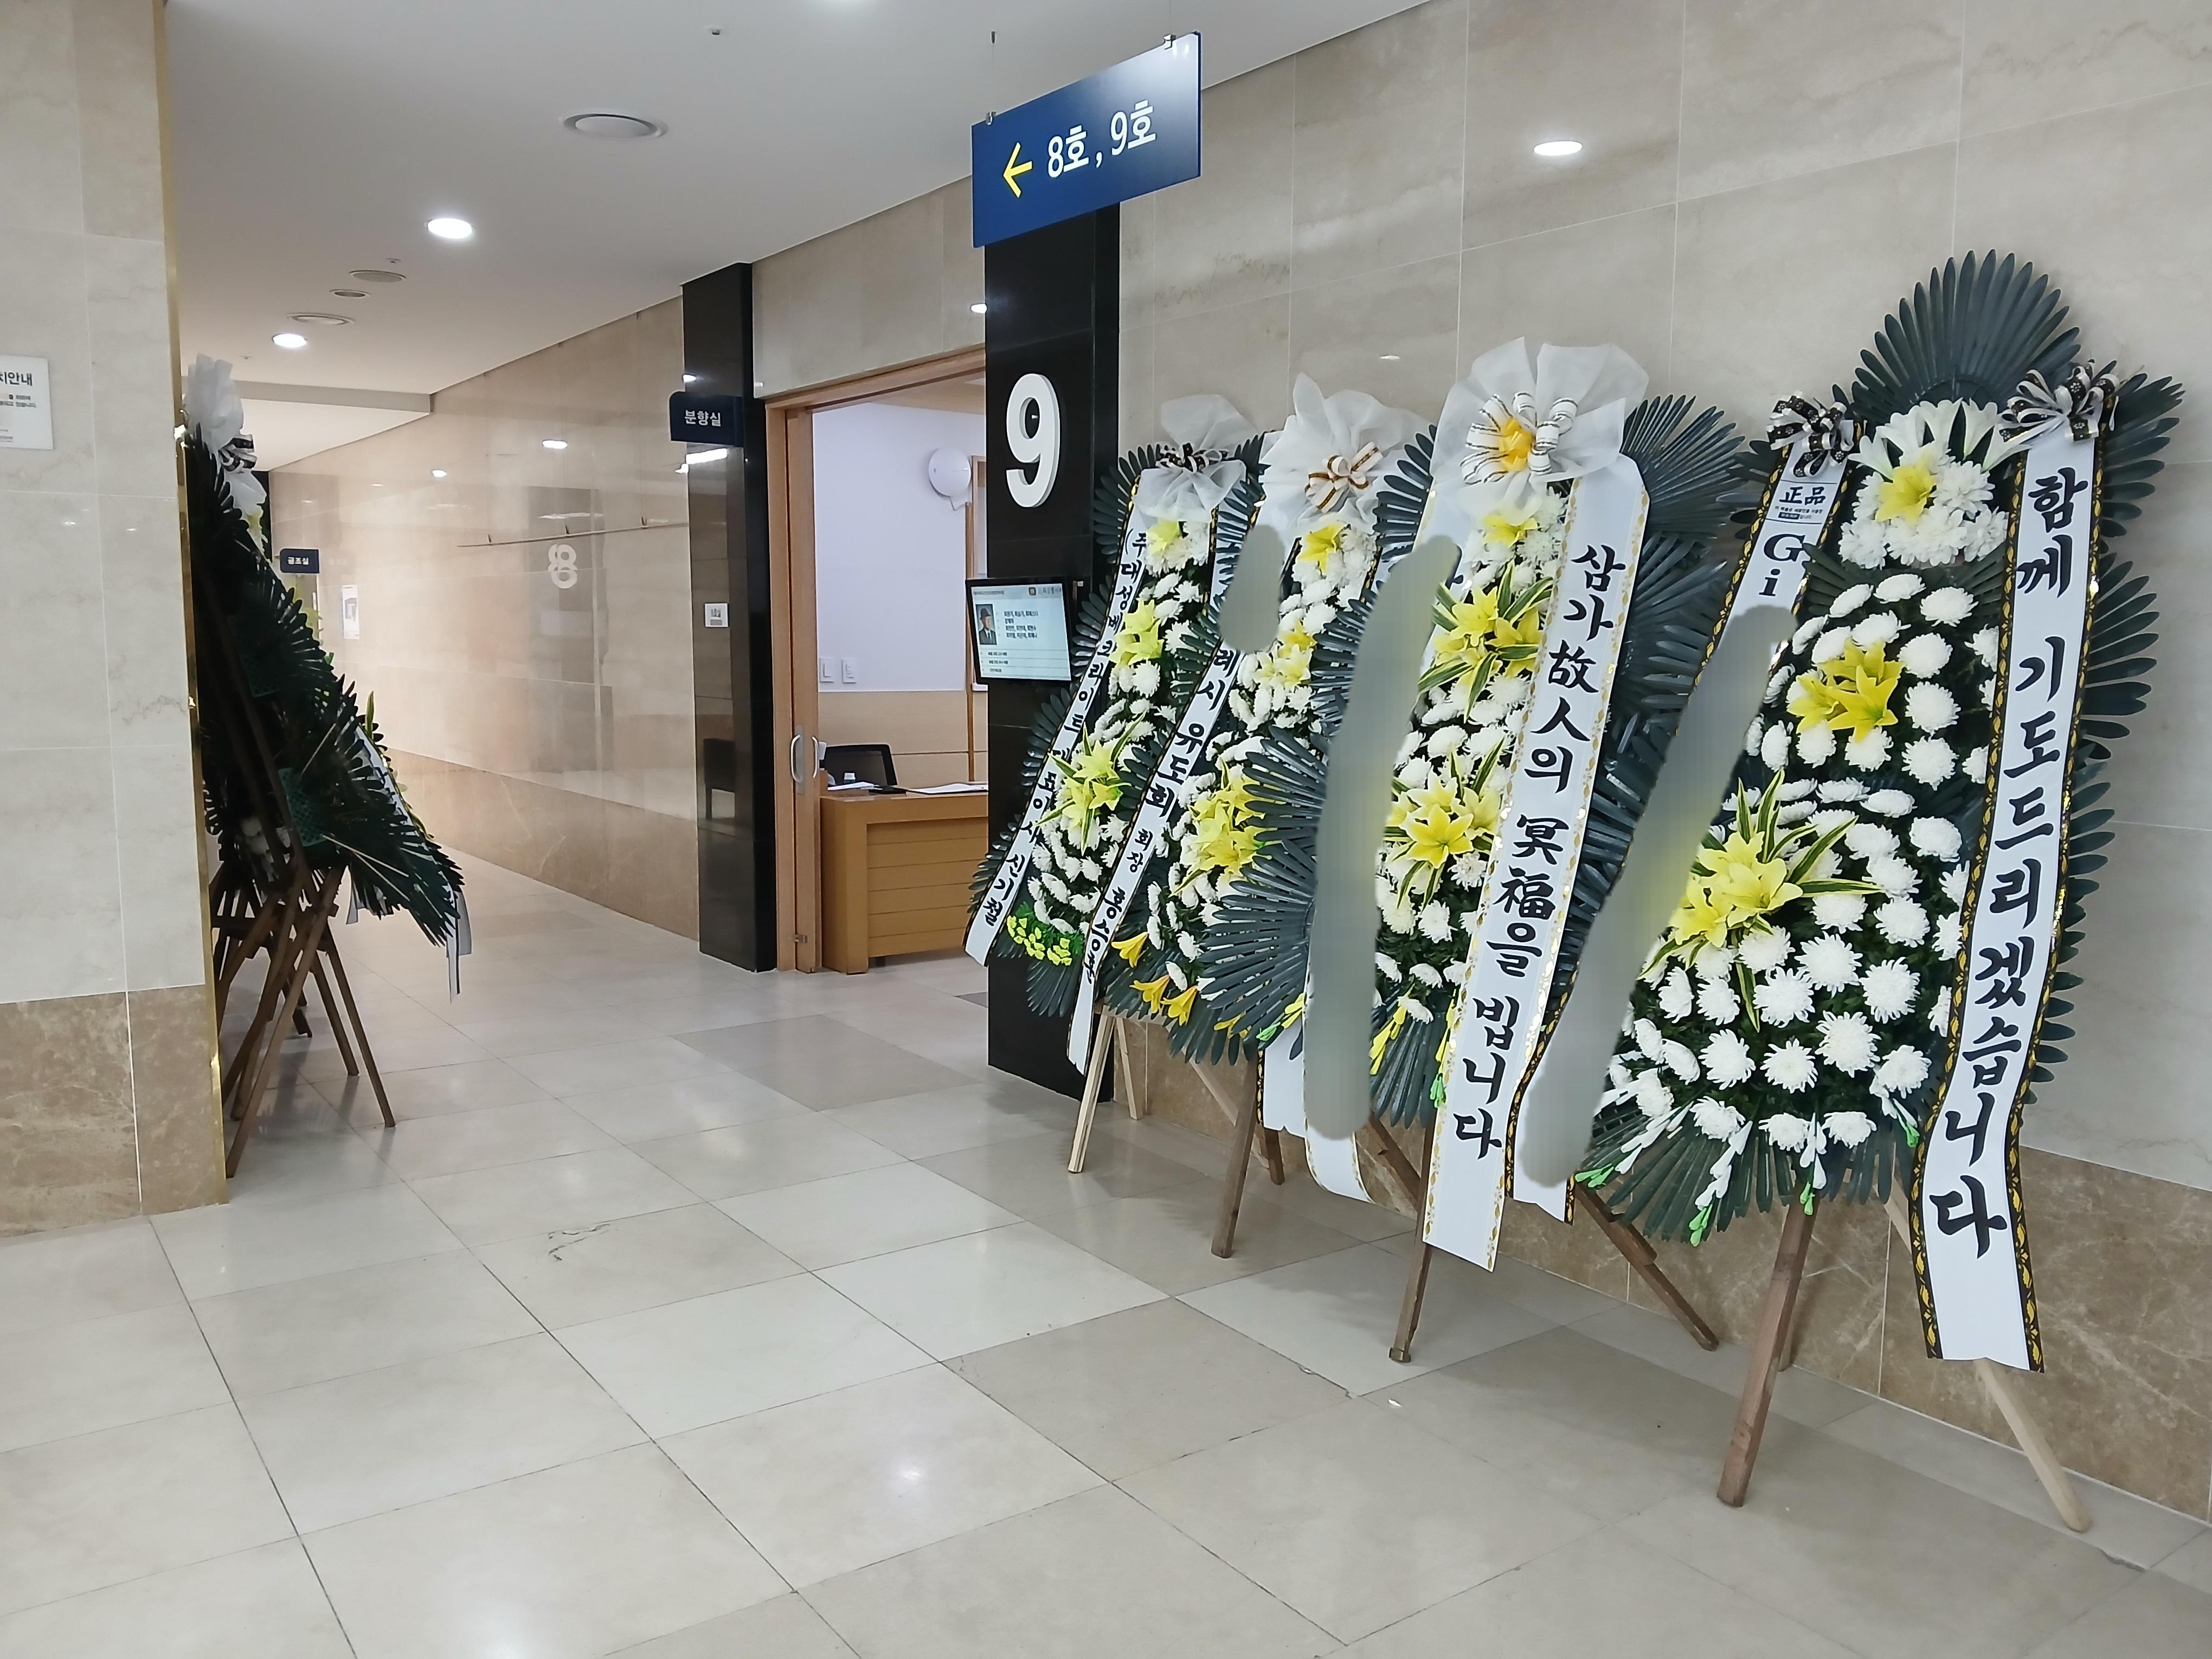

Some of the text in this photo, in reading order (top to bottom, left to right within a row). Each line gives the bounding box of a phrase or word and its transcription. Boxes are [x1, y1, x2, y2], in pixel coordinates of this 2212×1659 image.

[1110, 99, 1156, 156] 9호
[684, 409, 722, 427] 분향실
[1006, 374, 1061, 508] 9
[1779, 486, 1826, 505] 正品
[1144, 723, 1205, 818] 유도회
[1126, 828, 1154, 873] 회장
[1486, 813, 1570, 978] 冥福을
[1929, 466, 2088, 1259] 함께 기도드리겠습니다
[1453, 995, 1520, 1160] 빕니다
